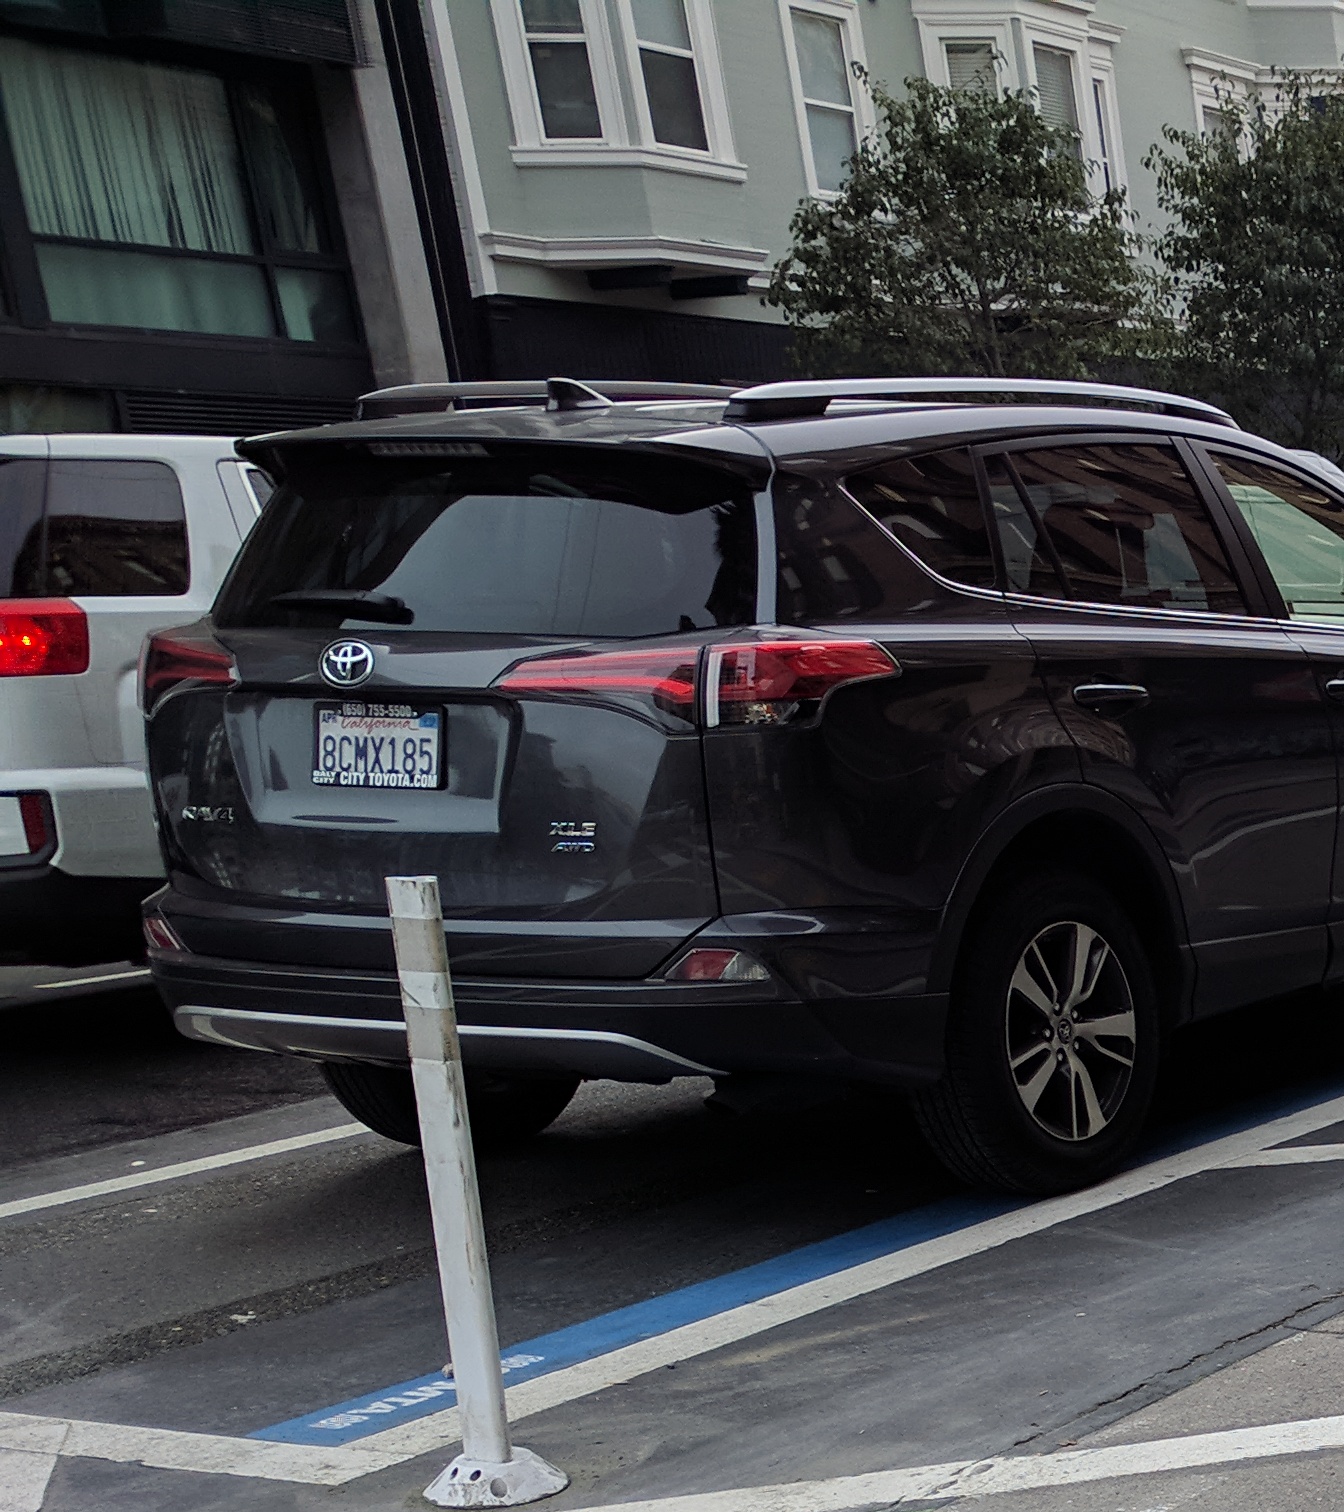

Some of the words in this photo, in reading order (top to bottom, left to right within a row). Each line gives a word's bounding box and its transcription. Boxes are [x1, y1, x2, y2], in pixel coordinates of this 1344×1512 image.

[340, 716, 420, 735] California
[322, 735, 433, 775] 8CMX185
[312, 776, 335, 784] CITY
[339, 770, 366, 786] CITY
[368, 772, 438, 789] TOYOTA.COM
[548, 821, 597, 837] XLE
